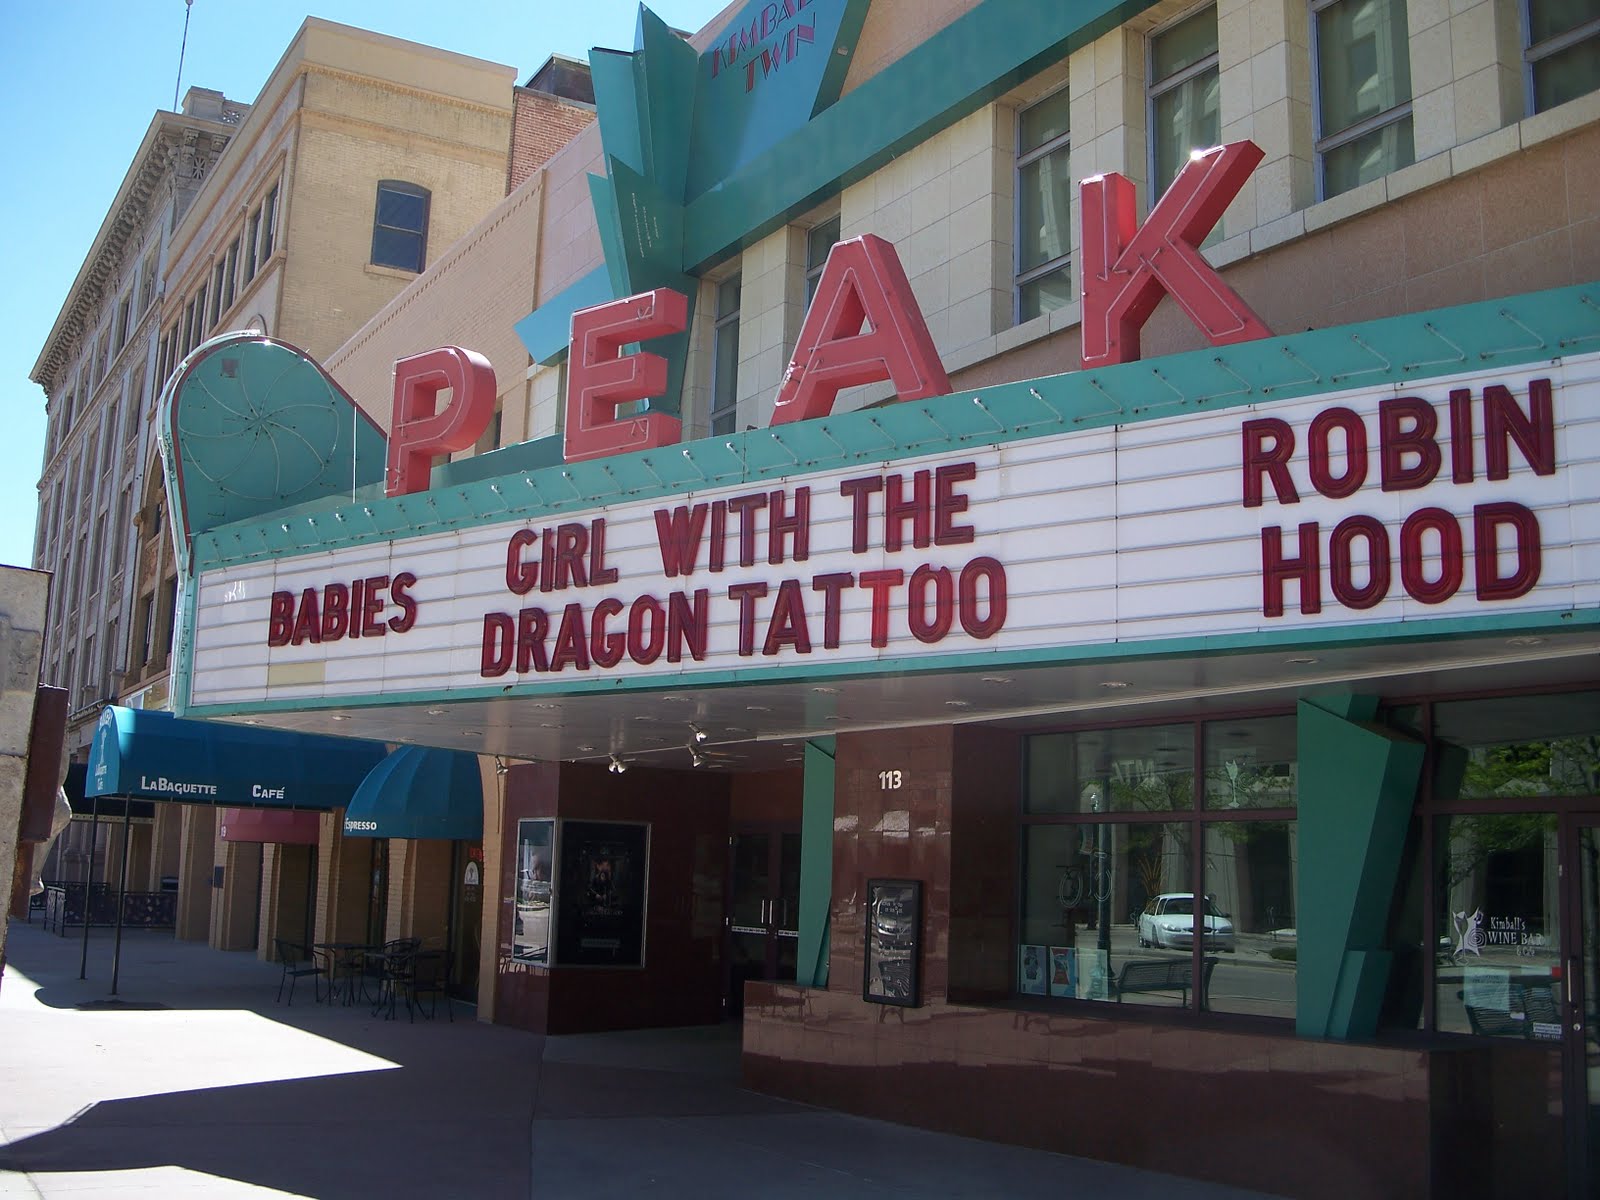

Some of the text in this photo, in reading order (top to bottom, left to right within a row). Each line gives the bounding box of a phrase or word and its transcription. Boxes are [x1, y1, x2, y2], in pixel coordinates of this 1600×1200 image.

[712, 0, 814, 79] KIMBA
[742, 12, 816, 94] TWIN
[384, 140, 1273, 495] PEAK
[1242, 378, 1556, 508] ROBIN
[506, 462, 976, 595] GIRL WITH THE
[1261, 502, 1542, 618] HOOD
[268, 572, 418, 647] BABIES
[481, 556, 1007, 677] DRAGON TATTOO
[879, 770, 902, 790] 113
[1487, 931, 1545, 946] WINE BAR
[1490, 917, 1526, 931] Kimball's
